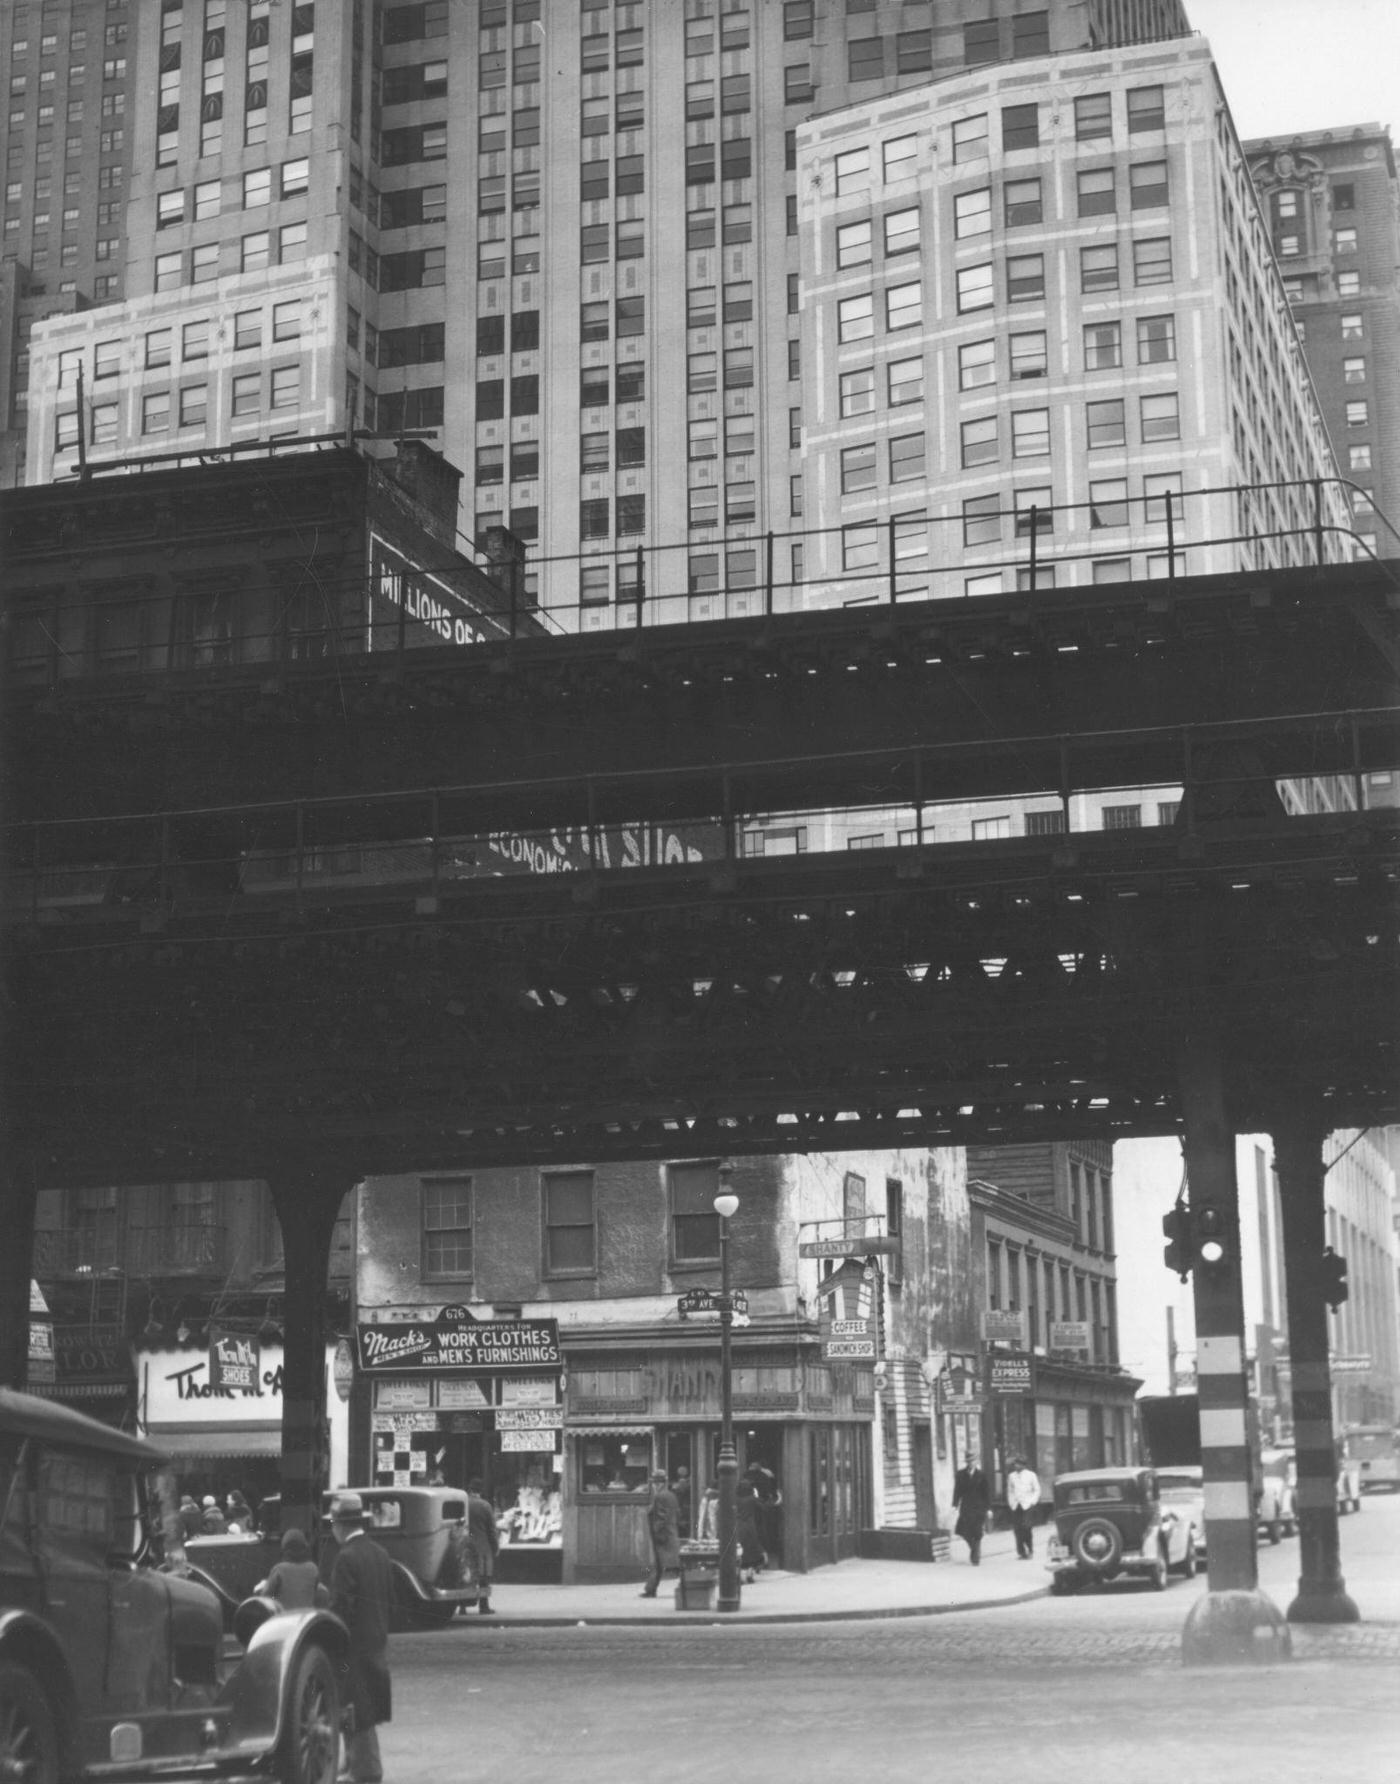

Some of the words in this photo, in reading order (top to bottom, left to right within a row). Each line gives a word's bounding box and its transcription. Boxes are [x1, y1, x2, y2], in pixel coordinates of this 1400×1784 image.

[806, 1242, 851, 1256] SHANTY
[699, 1298, 714, 1309] AVE
[446, 1308, 465, 1319] 676
[517, 1323, 532, 1331] FOR
[834, 1322, 864, 1332] COFFEE
[438, 1332, 478, 1347] WORK
[482, 1330, 551, 1346] CLOTHES
[829, 1344, 856, 1355] SANDWICH
[858, 1343, 872, 1354] SHOP
[422, 1355, 438, 1364] AND
[439, 1348, 472, 1364] MEN'S
[477, 1347, 557, 1363] FURNISHINGS
[223, 1368, 250, 1383] SHOES
[992, 1368, 1031, 1378] EXPRESS
